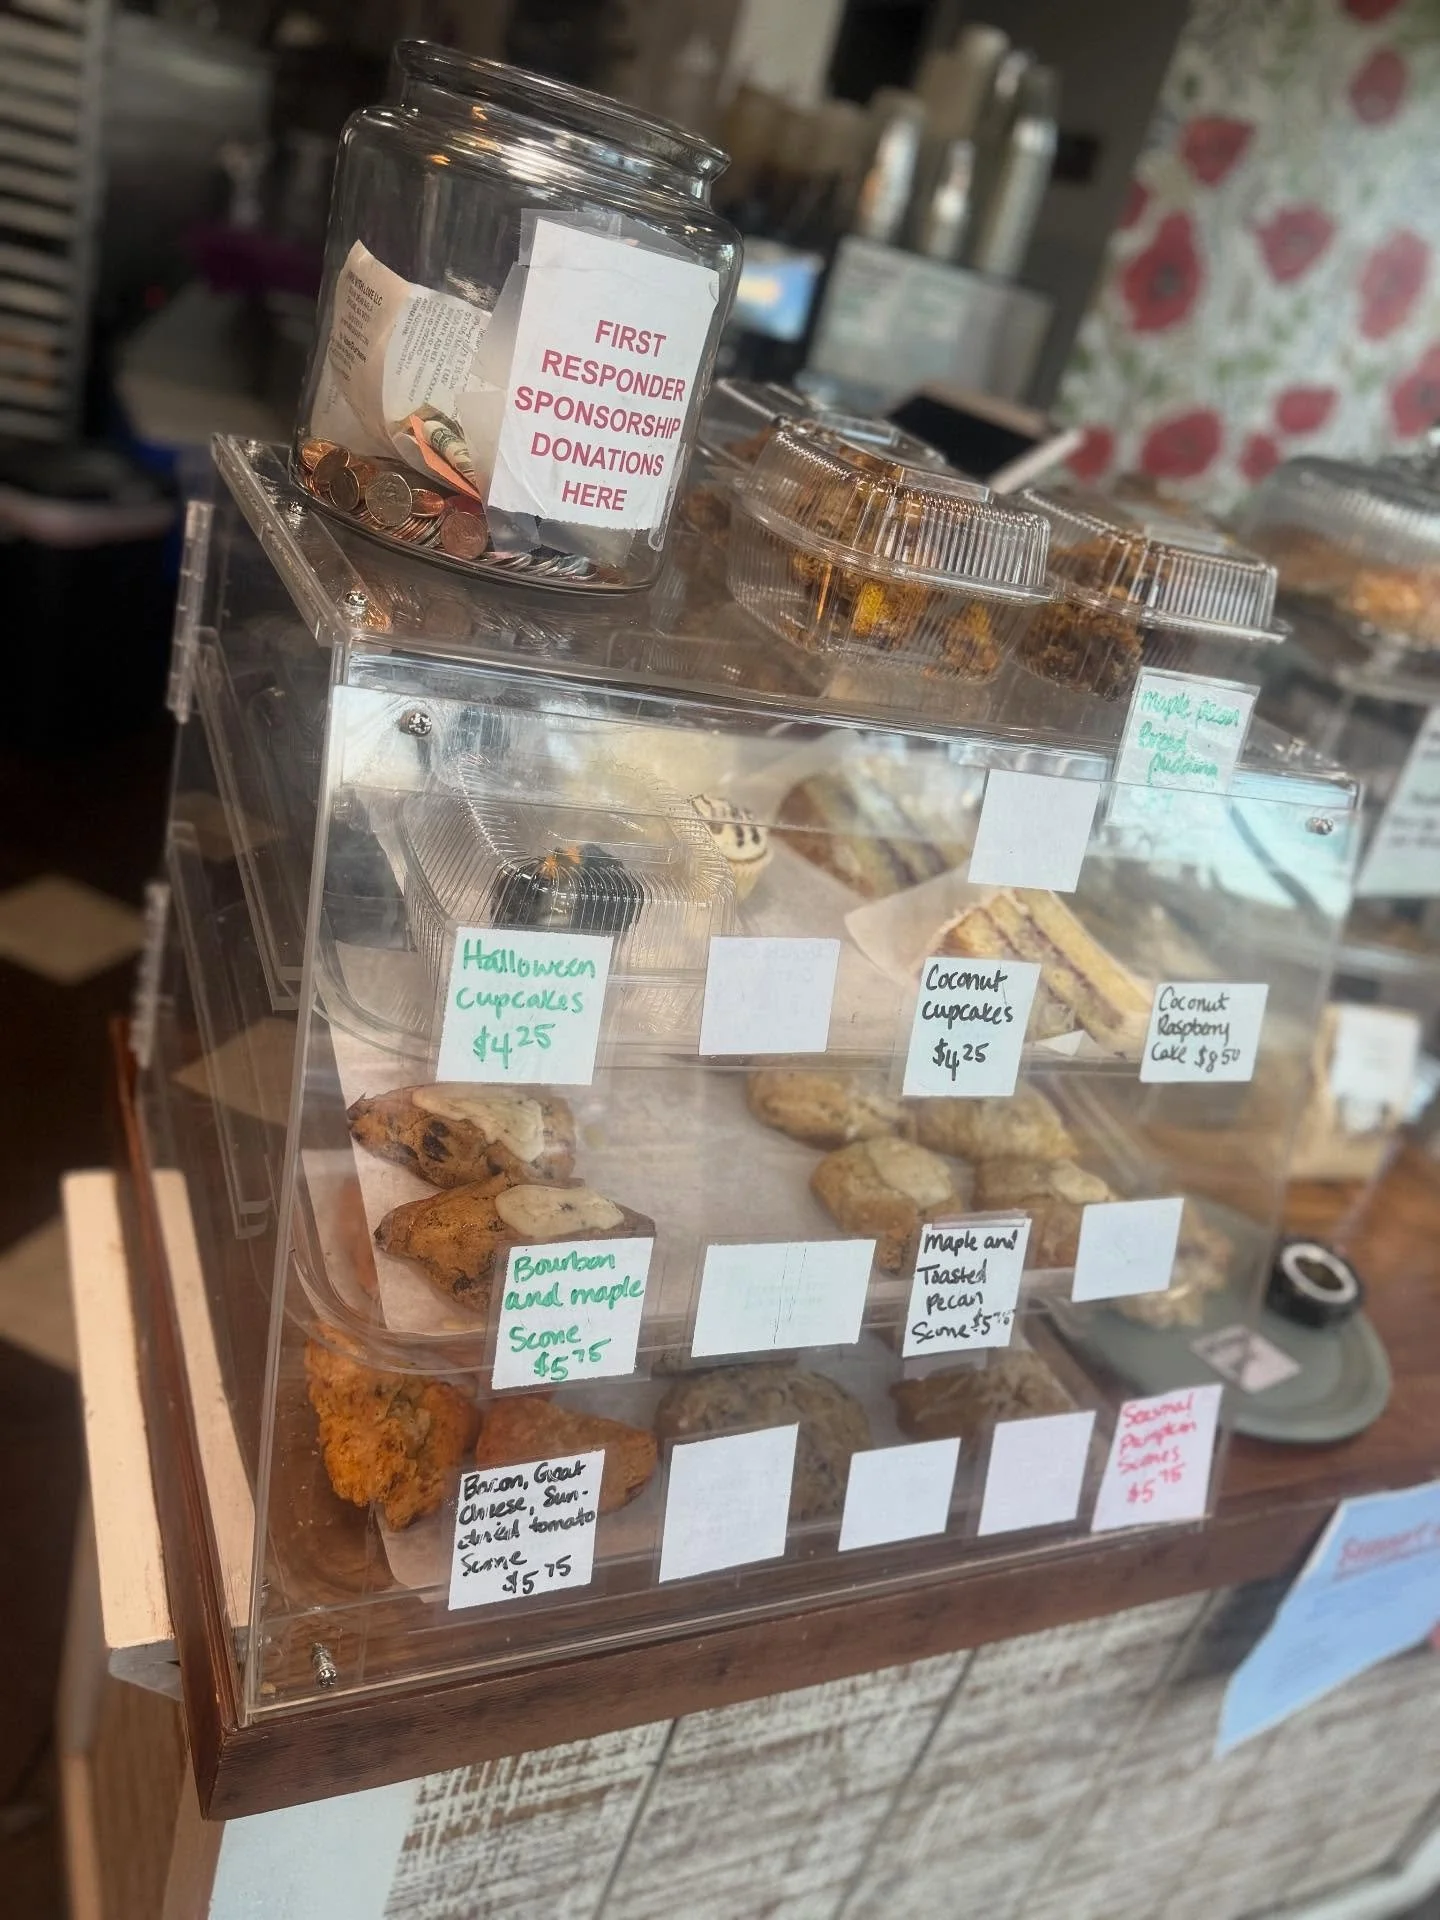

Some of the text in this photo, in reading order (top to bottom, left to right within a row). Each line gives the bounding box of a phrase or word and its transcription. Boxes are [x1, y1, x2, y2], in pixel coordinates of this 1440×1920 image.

[594, 319, 667, 357] FIRST
[541, 350, 685, 402] RESPONDER
[514, 386, 681, 439] SPONSORSHIP
[530, 432, 665, 477] DONATIONS
[562, 481, 627, 511] HERE
[463, 938, 596, 978] Halloween
[926, 964, 1008, 992] Coconut
[1159, 986, 1229, 1012] Coconut
[1151, 1042, 1186, 1064] Cake
[984, 1230, 1018, 1250] and
[514, 1251, 615, 1283] Bourbon
[917, 1258, 988, 1285] Toasted
[504, 1276, 644, 1310] and maple
[509, 1325, 582, 1352] Scone
[912, 1322, 971, 1344] Scone
[529, 1508, 596, 1533] tomato
